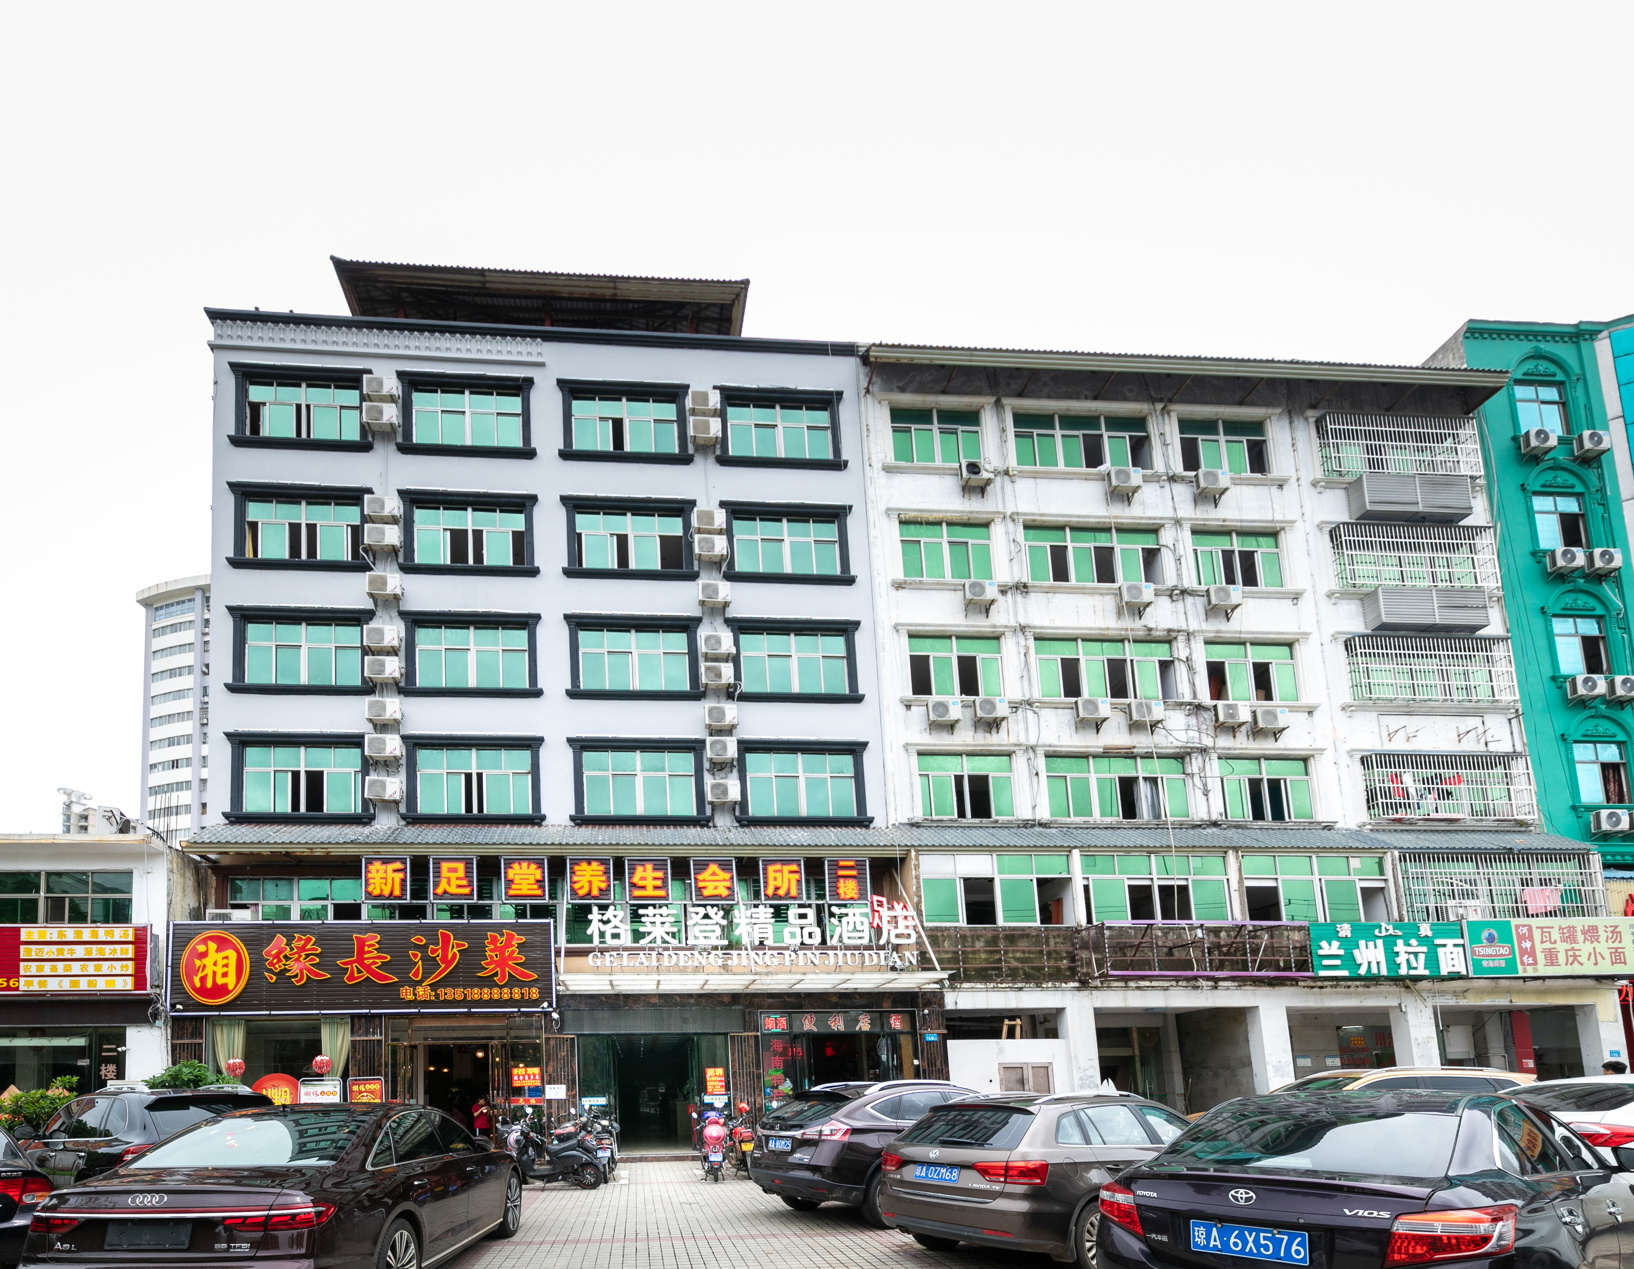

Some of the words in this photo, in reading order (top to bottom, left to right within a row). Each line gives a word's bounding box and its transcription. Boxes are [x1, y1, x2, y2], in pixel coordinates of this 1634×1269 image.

[586, 903, 918, 946] 格莱登精品酒店
[1536, 925, 1623, 945] 瓦罐煨汤
[1317, 938, 1468, 977] 兰州拉面
[1474, 946, 1510, 956] TSINGTAO
[1541, 946, 1628, 967] 重庆小面
[100, 1045, 118, 1080] 二楼
[1136, 1190, 1158, 1198] TOYOTA
[1342, 1208, 1392, 1219] VIOS
